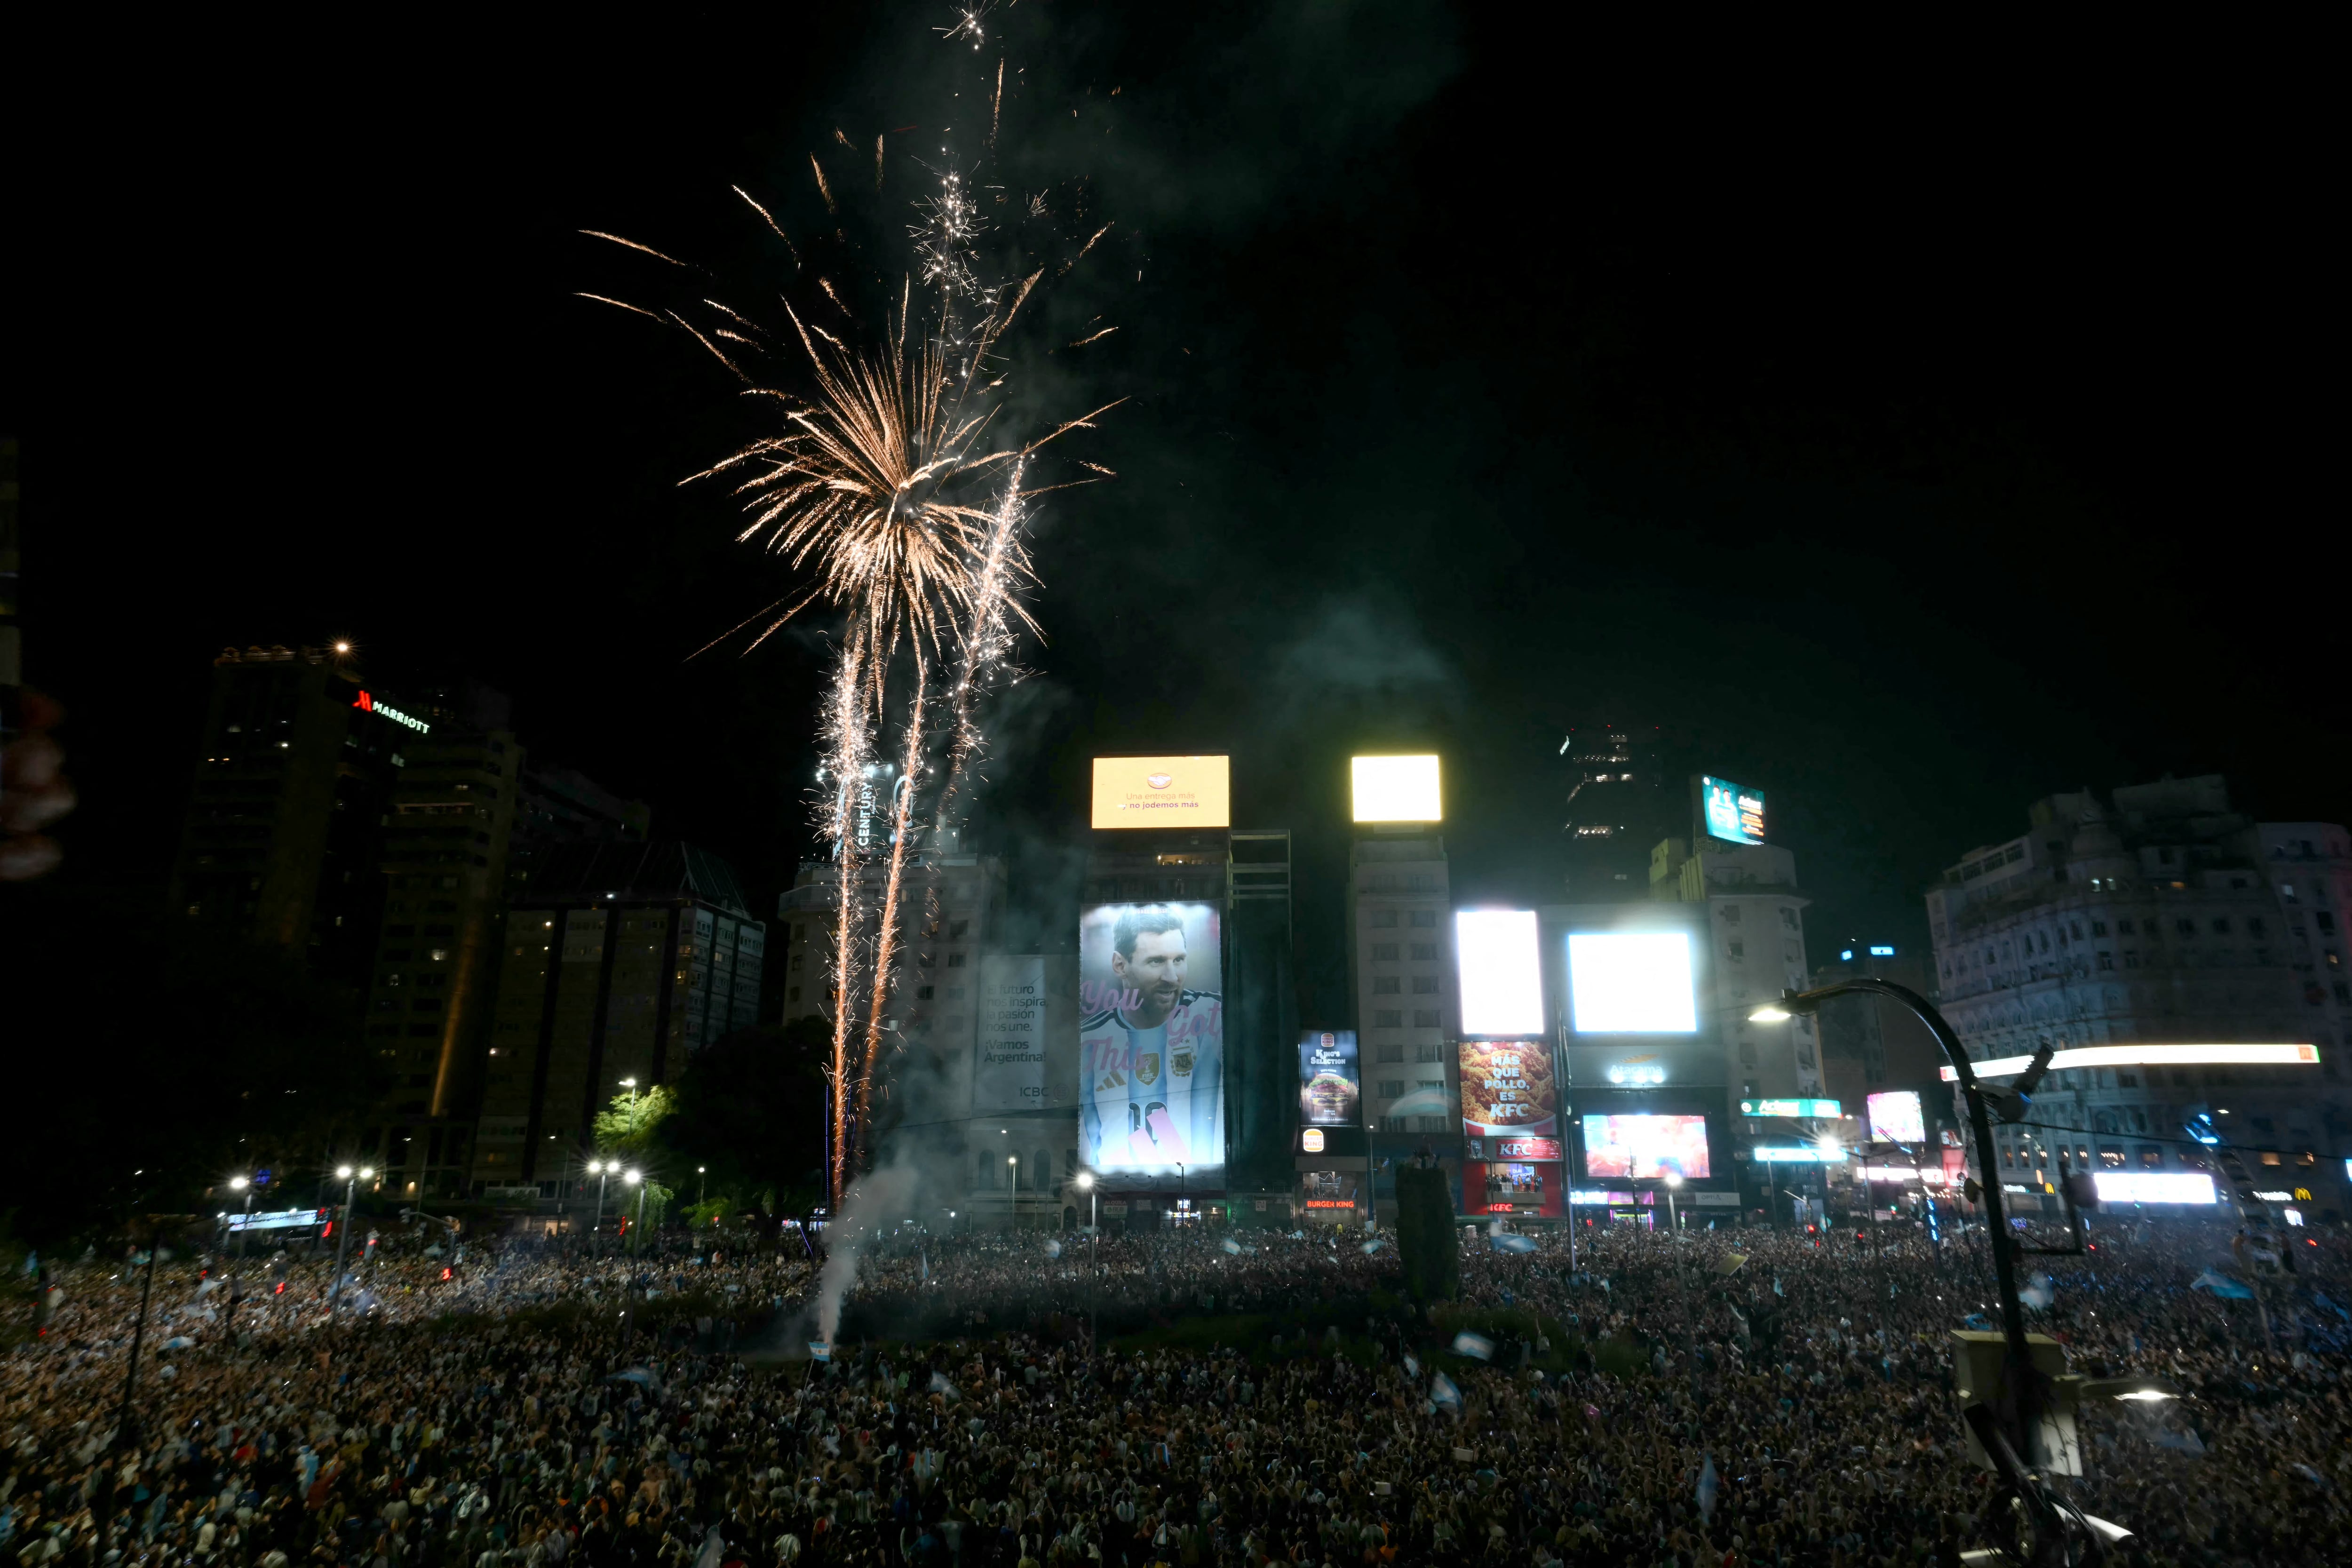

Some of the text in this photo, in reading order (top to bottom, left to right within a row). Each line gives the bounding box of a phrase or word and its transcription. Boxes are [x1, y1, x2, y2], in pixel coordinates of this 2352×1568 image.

[372, 700, 430, 734] MARRIOTT
[858, 782, 873, 846] CENTURY
[988, 984, 1034, 994] El futuro
[987, 996, 1048, 1008] nos inspira,
[1081, 979, 1144, 1015] You
[987, 1009, 1034, 1021] la pasión
[986, 1023, 1033, 1032] nos une.
[1167, 1002, 1222, 1047] Got
[985, 1039, 1029, 1052] ¡Vamos
[984, 1052, 1047, 1065] Argentina!
[1081, 1036, 1150, 1072] This
[1491, 1053, 1520, 1066] MÁS
[1493, 1067, 1520, 1079] QUE
[1610, 1065, 1663, 1075] Atacama
[1484, 1079, 1530, 1090] POLLO,
[1020, 1087, 1049, 1097] ICBC
[1500, 1091, 1516, 1101] ES
[1490, 1103, 1529, 1117] KFC
[1500, 1143, 1533, 1155] KFC
[1490, 1203, 1512, 1212] KFC
